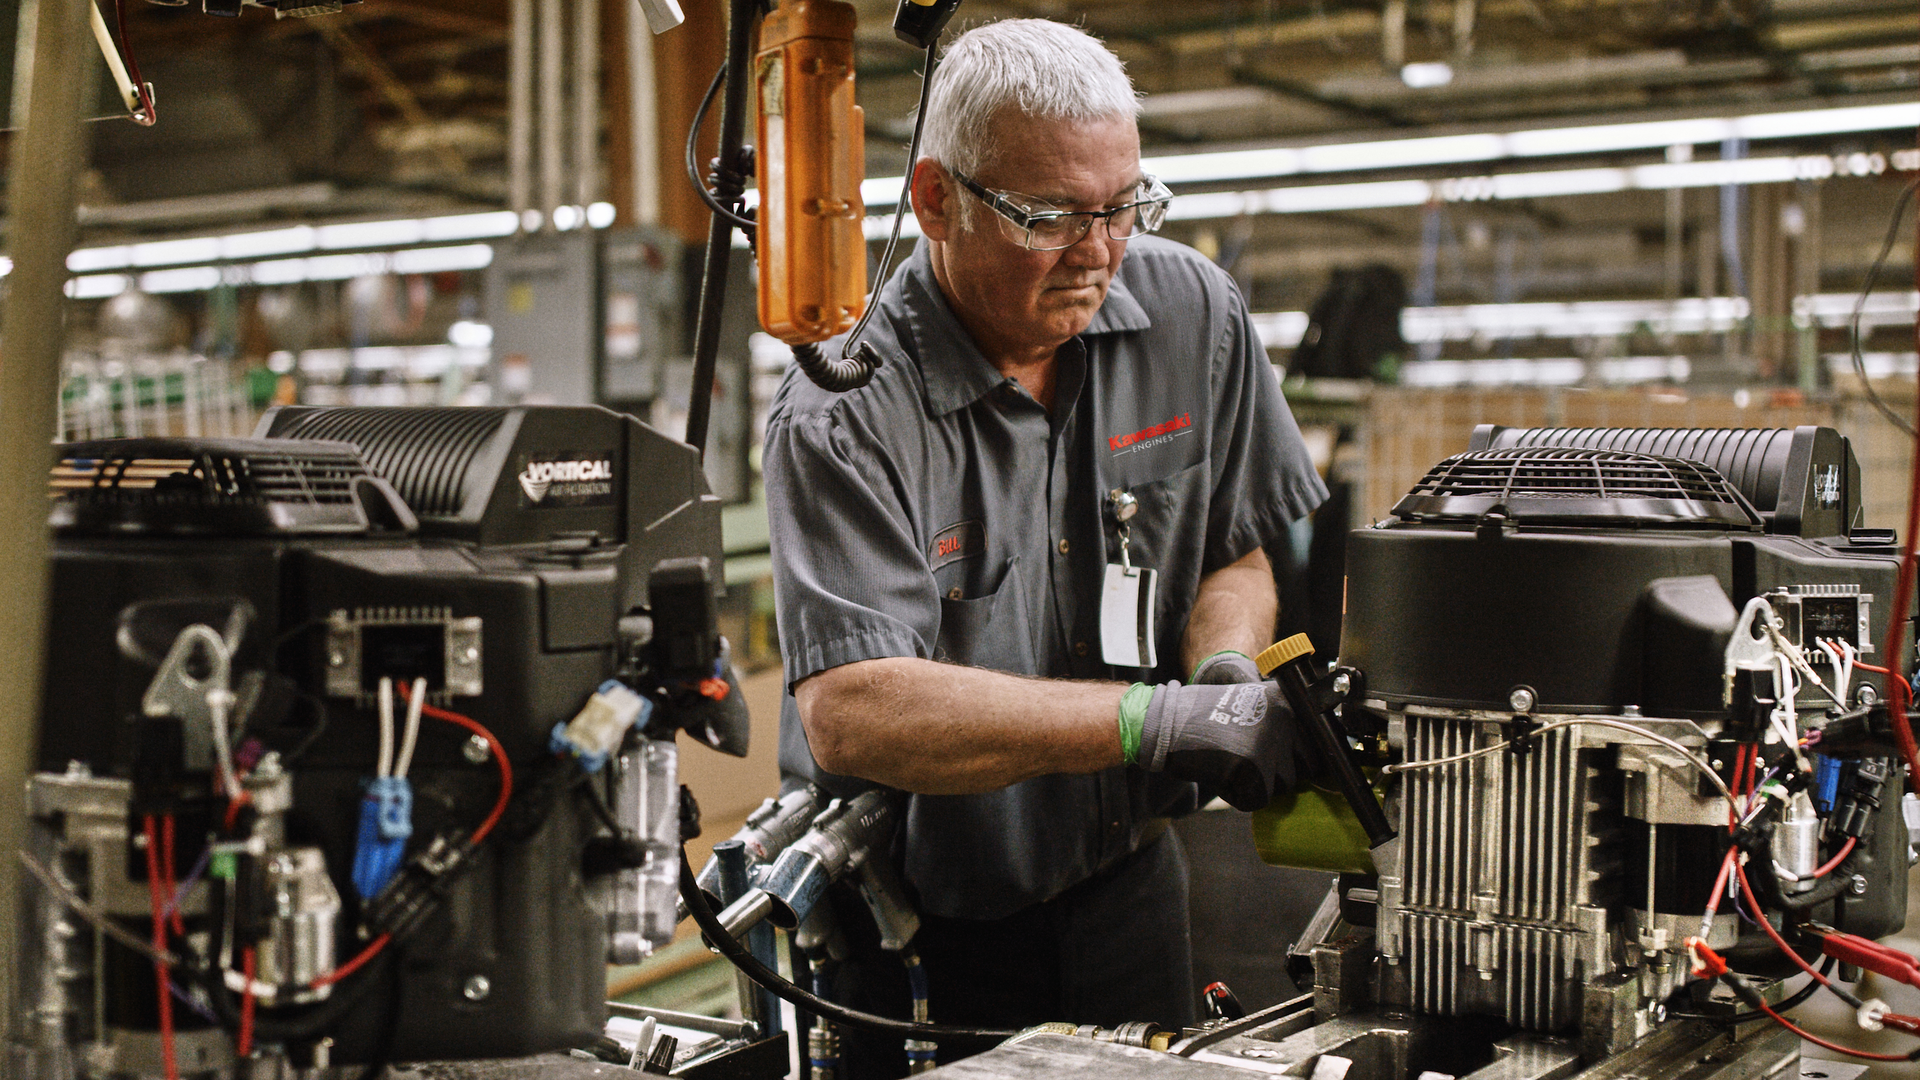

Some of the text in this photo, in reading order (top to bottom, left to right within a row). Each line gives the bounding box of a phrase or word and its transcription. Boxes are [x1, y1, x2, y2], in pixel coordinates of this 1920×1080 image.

[1108, 412, 1192, 451] Kawasaki
[1132, 434, 1174, 453] ENGINES
[527, 460, 613, 482] VORTICAL
